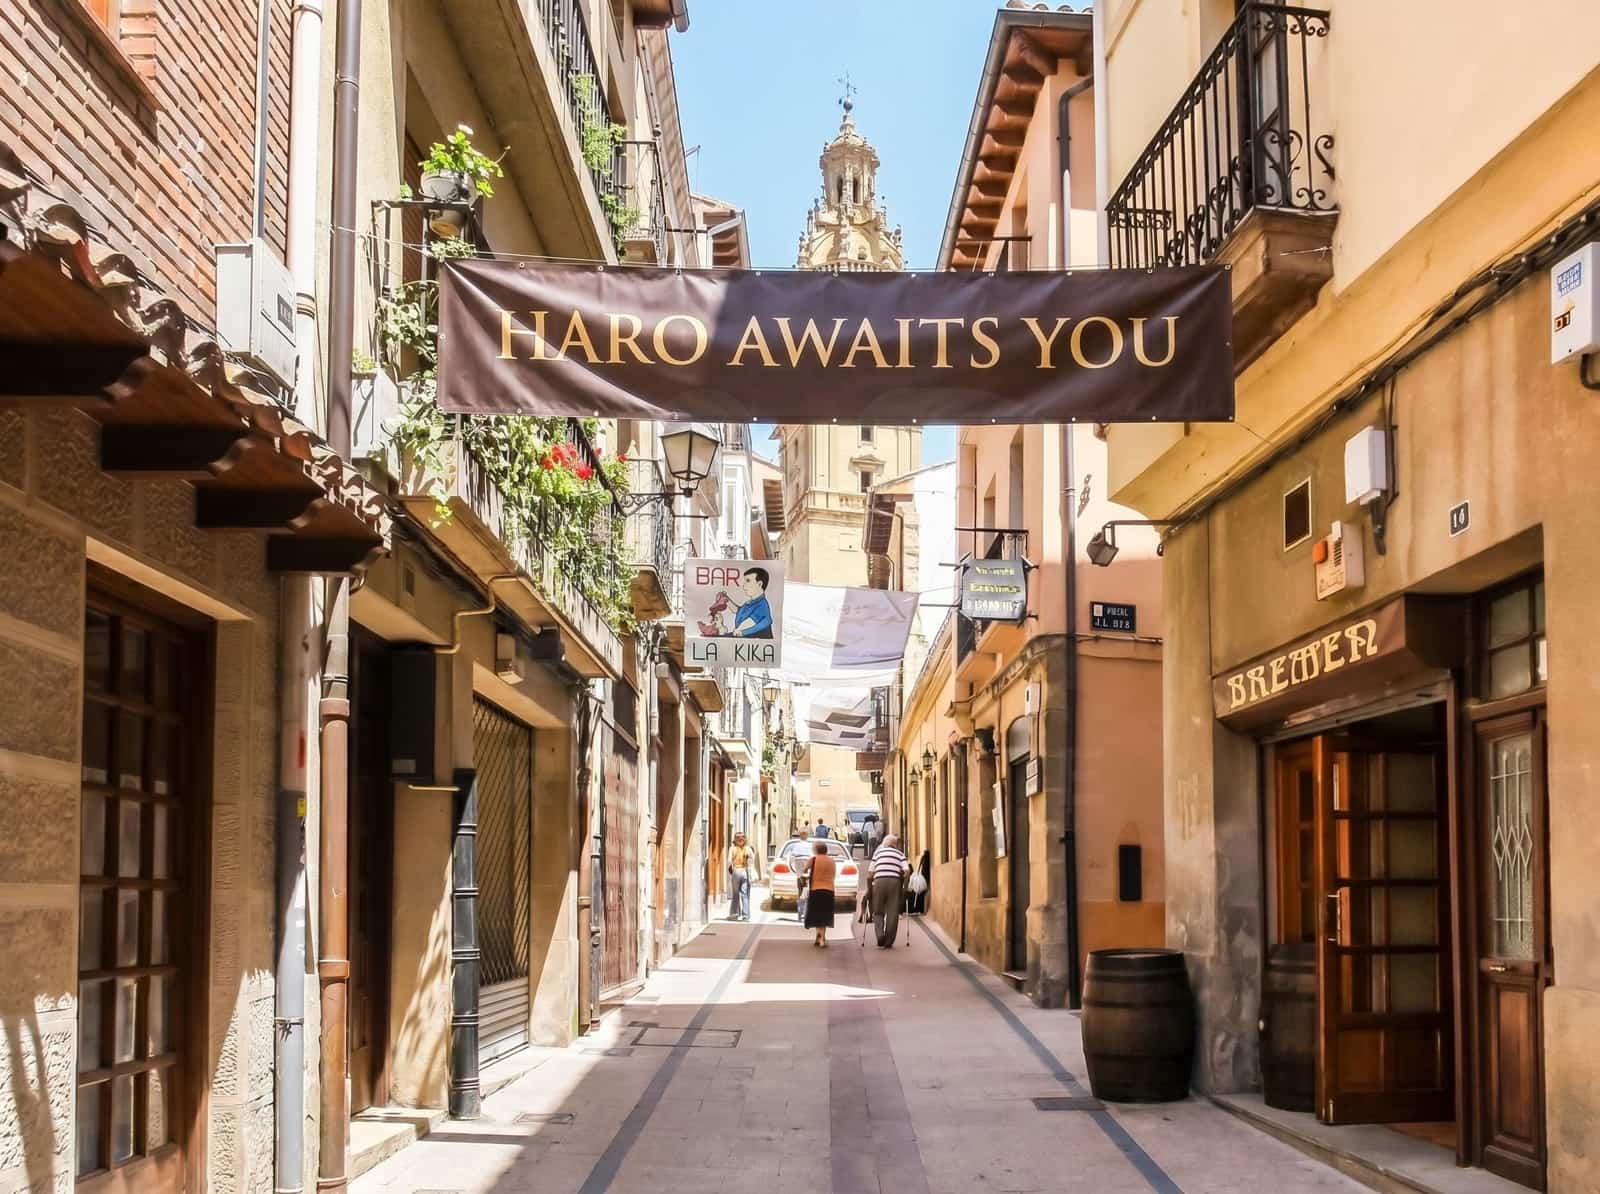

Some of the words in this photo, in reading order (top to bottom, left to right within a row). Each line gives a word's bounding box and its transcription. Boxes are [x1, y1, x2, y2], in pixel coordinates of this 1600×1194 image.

[496, 309, 711, 366] HARO
[726, 315, 1000, 368] AWAITS
[1019, 316, 1181, 369] YOU
[695, 566, 741, 587] BAR
[692, 641, 718, 662] LA
[734, 643, 775, 663] KIKA
[1227, 618, 1378, 709] BREMEN
